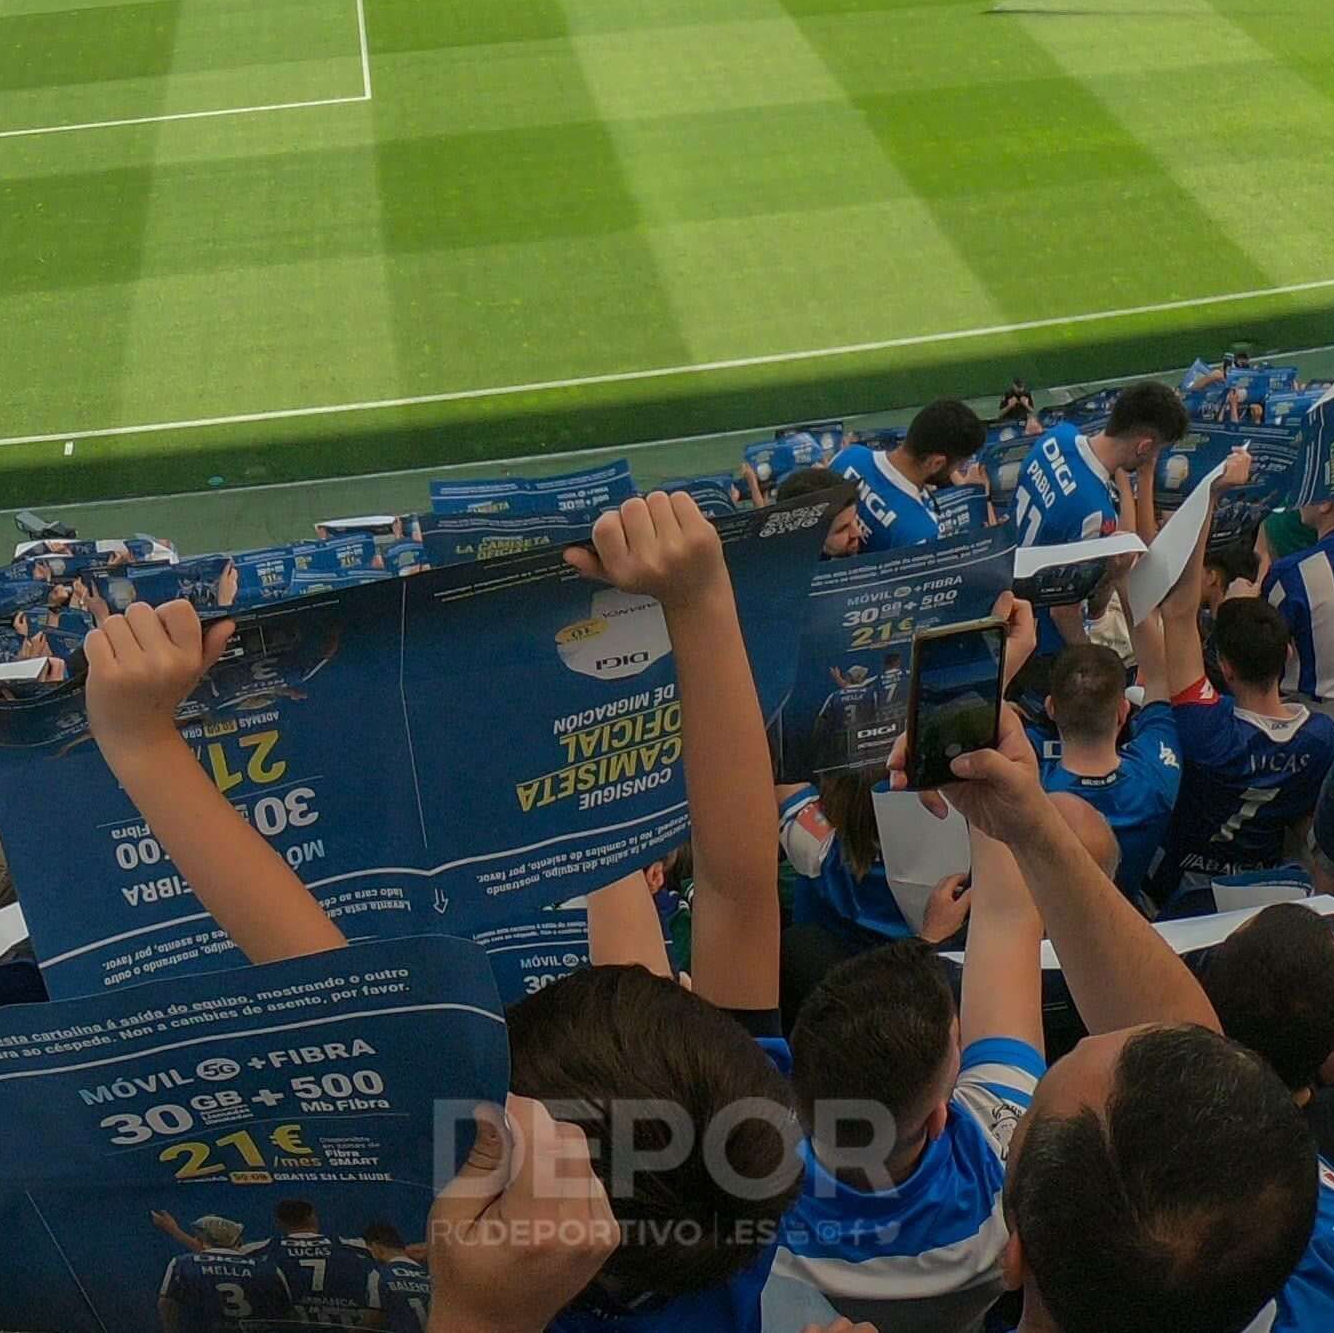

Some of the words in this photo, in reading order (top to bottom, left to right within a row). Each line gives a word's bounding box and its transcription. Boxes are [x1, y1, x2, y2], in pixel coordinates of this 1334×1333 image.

[1042, 437, 1077, 496] DIGI
[1027, 460, 1056, 509] PABLO
[842, 607, 879, 626] 30
[921, 590, 957, 605] 500
[596, 651, 649, 670] DIGI
[553, 691, 650, 735] MIGRACIÓN
[559, 702, 682, 763] OFICIAL
[857, 723, 896, 739] DIGI
[517, 736, 682, 812] CAMISETA
[579, 768, 672, 810] CONSIGUE
[255, 787, 318, 836] 30
[1210, 787, 1282, 842] 7
[112, 824, 149, 839] Fibra
[104, 969, 131, 985] outro
[144, 950, 199, 973] mostrando
[520, 954, 562, 970] MÓVIL
[22, 1047, 42, 1057] ao
[45, 1035, 117, 1055] céspede.
[120, 1027, 154, 1042] Non
[158, 1022, 167, 1033] a
[242, 1003, 263, 1015] de
[267, 994, 328, 1013] asento,
[331, 988, 358, 1003] por
[362, 981, 410, 998] favor.
[32, 1020, 103, 1043] cartolina
[121, 1008, 164, 1027] saída
[167, 1002, 188, 1016] do
[257, 977, 345, 1001] mostrando
[349, 974, 360, 984] o
[364, 967, 409, 983] outro
[78, 1068, 194, 1106] MÓVIL
[203, 1062, 237, 1078] 5G
[99, 1104, 194, 1146] 30
[190, 1089, 243, 1112] GB
[290, 1070, 384, 1099] 500
[300, 1100, 337, 1113] Mb
[338, 1098, 390, 1111] Fibra
[272, 1156, 323, 1167] /mes
[324, 1150, 360, 1158] Fibra
[329, 1157, 379, 1166] SMART
[287, 1247, 331, 1257] LUCAS
[202, 1266, 252, 1279] MELLA
[299, 1259, 326, 1291] 7
[216, 1283, 252, 1317] 3
